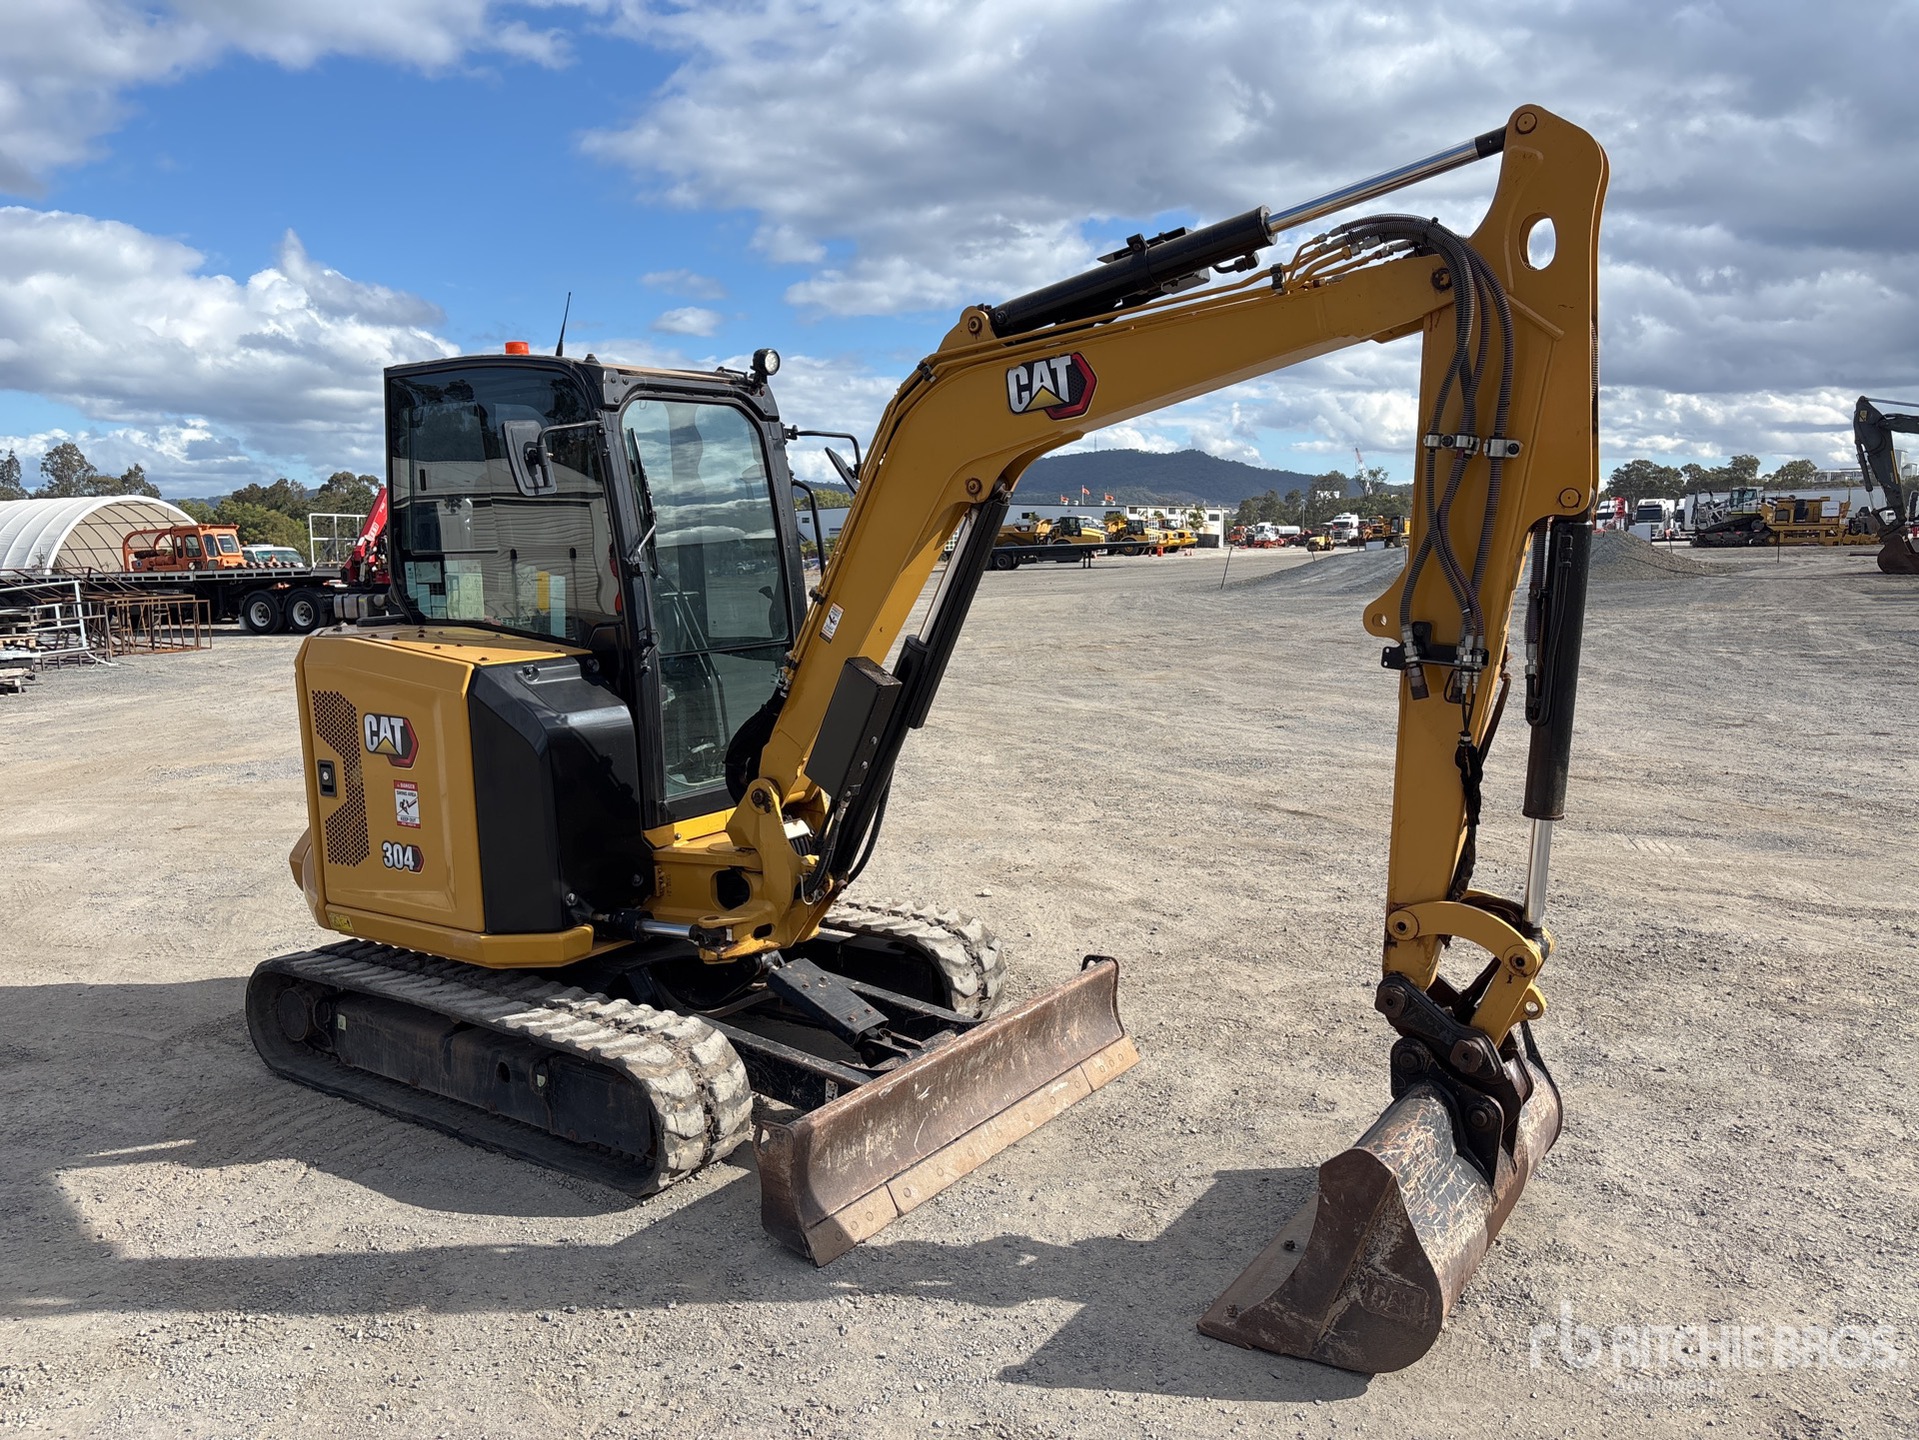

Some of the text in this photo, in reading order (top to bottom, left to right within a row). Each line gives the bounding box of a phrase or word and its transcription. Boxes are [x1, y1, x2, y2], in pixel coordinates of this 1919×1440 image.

[1007, 355, 1072, 413] CAT
[363, 713, 404, 756] CAT
[383, 841, 415, 871] 304
